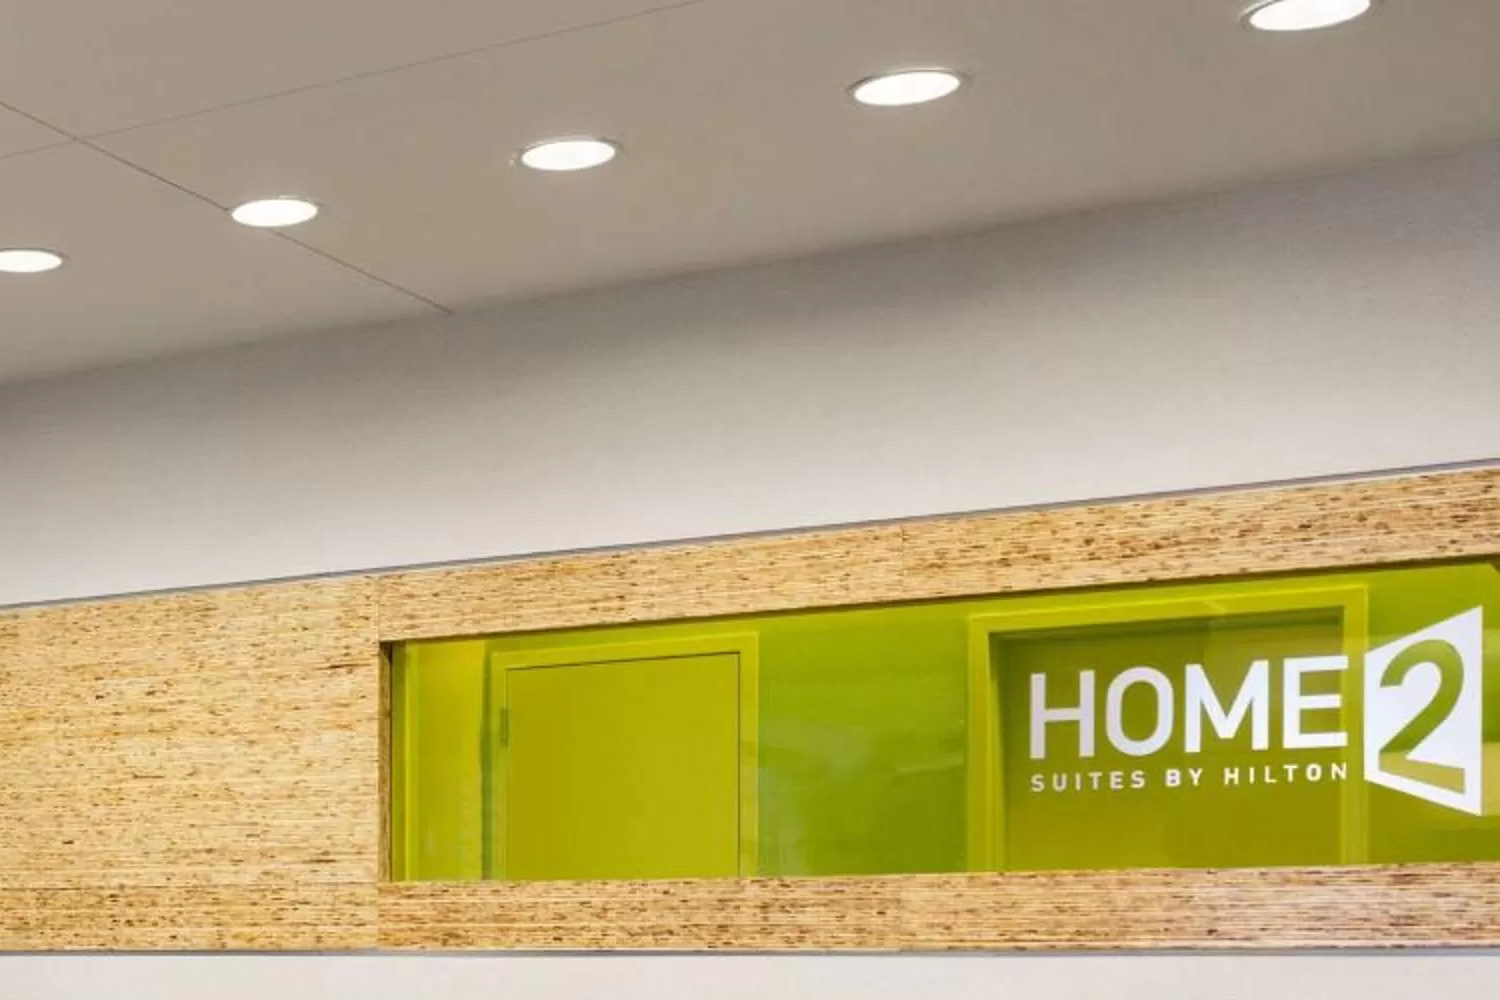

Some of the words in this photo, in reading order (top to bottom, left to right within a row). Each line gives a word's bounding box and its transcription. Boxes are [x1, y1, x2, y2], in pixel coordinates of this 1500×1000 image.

[1030, 655, 1348, 759] HOME
[1030, 771, 1146, 793] SUITES
[1165, 768, 1205, 788] BY
[1223, 763, 1348, 785] HILTON
